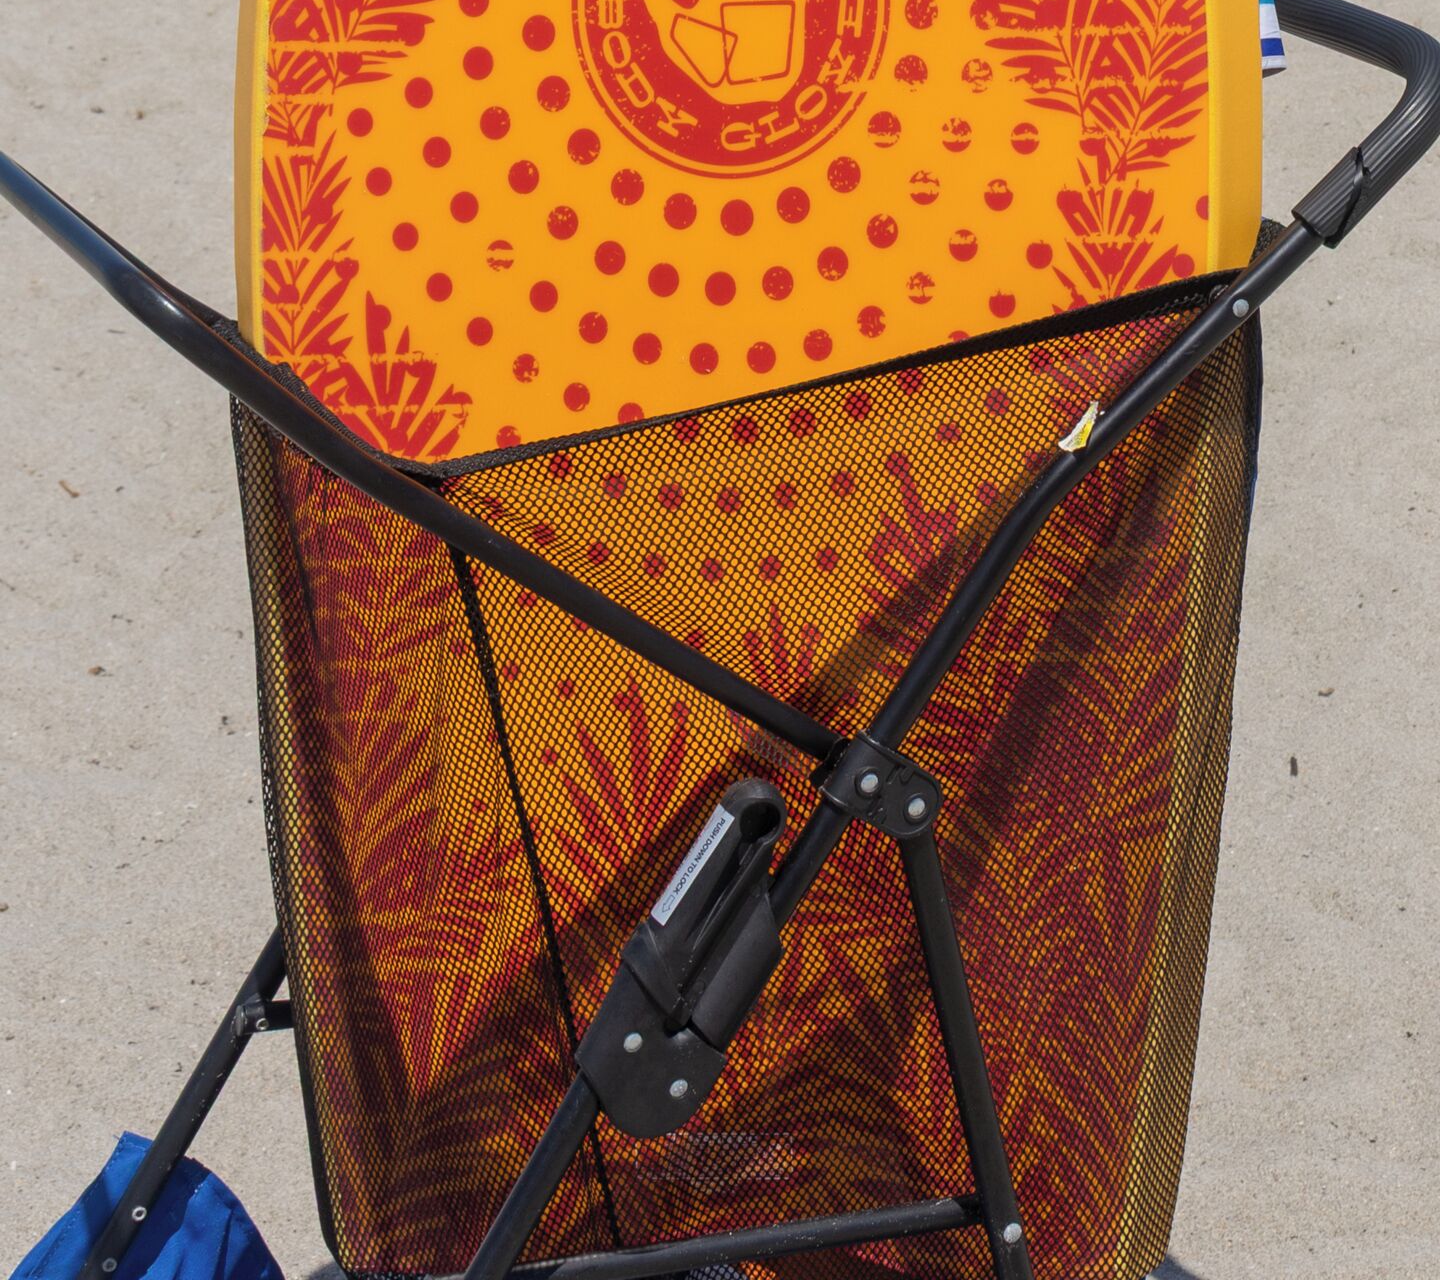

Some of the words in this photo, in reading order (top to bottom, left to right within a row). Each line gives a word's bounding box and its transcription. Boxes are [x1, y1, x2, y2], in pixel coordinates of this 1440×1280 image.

[711, 818, 726, 840] PUSH
[694, 838, 712, 863] DOWN
[687, 861, 697, 874] TO
[673, 873, 690, 895] LOCK
